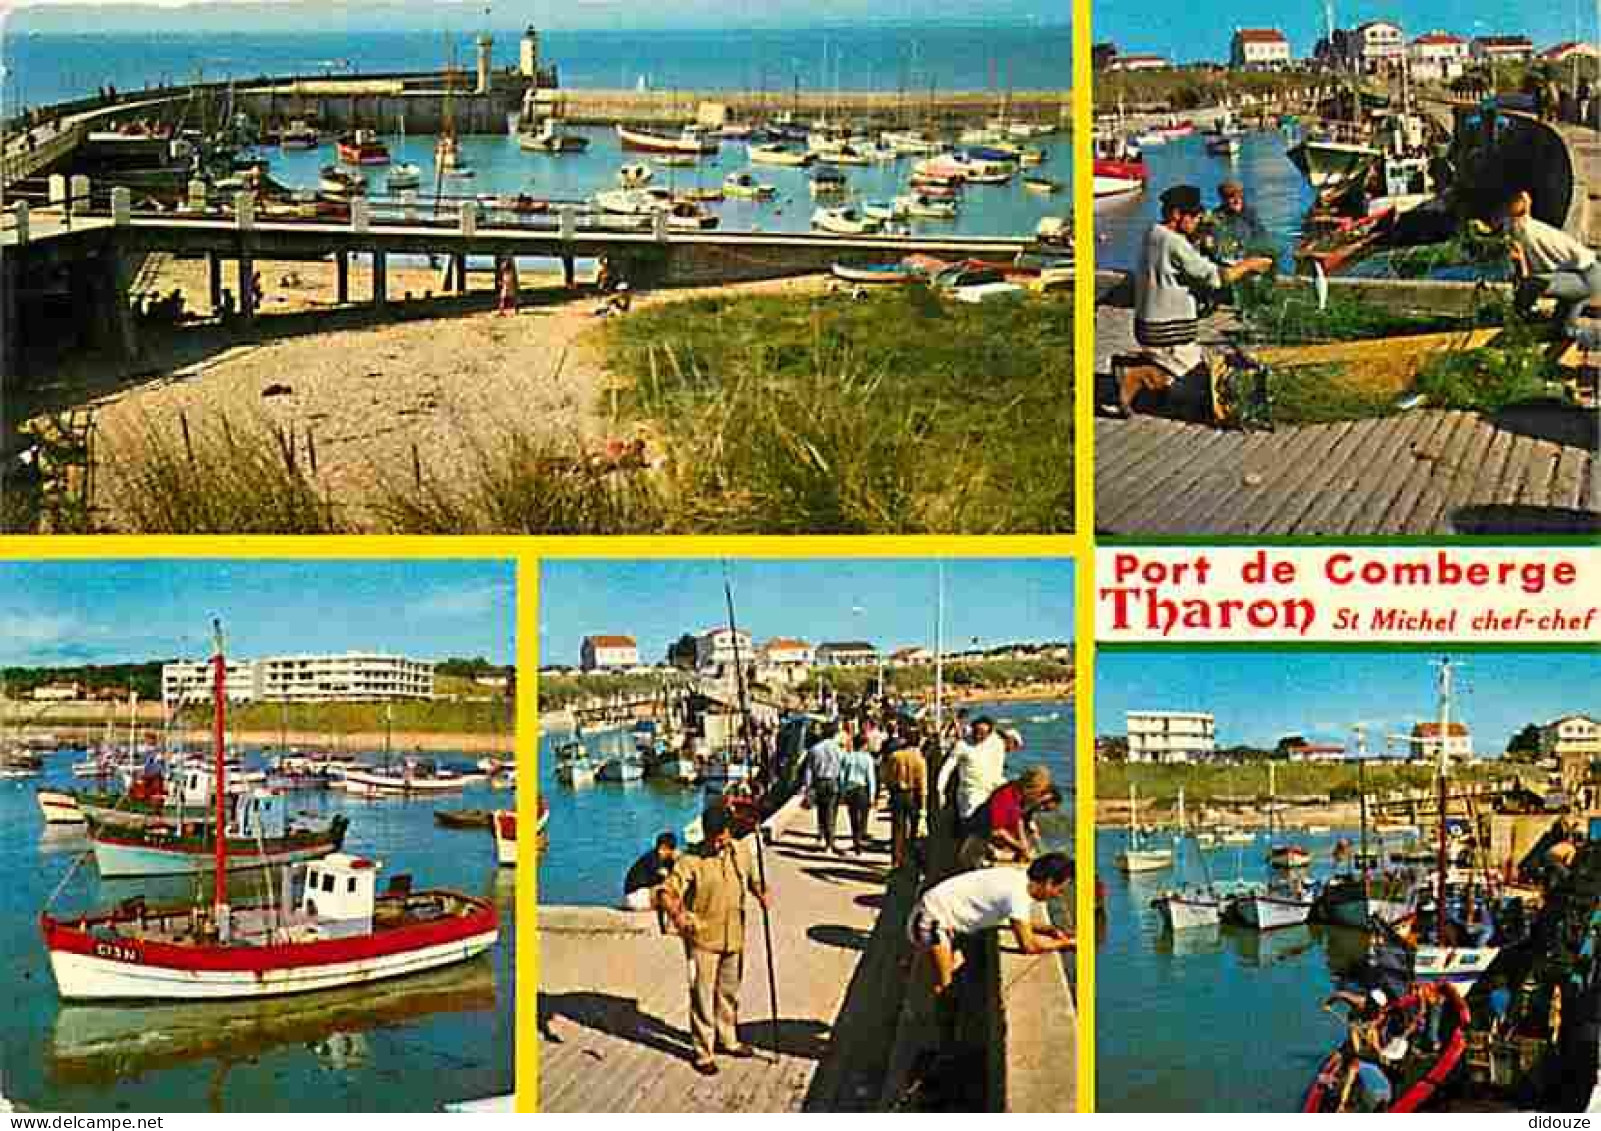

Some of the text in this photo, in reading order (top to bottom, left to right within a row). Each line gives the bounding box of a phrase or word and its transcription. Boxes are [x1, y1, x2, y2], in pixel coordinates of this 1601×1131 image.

[1115, 550, 1577, 594] Port de Comberge
[1099, 587, 1597, 636] Tharon St Michel chef-chef
